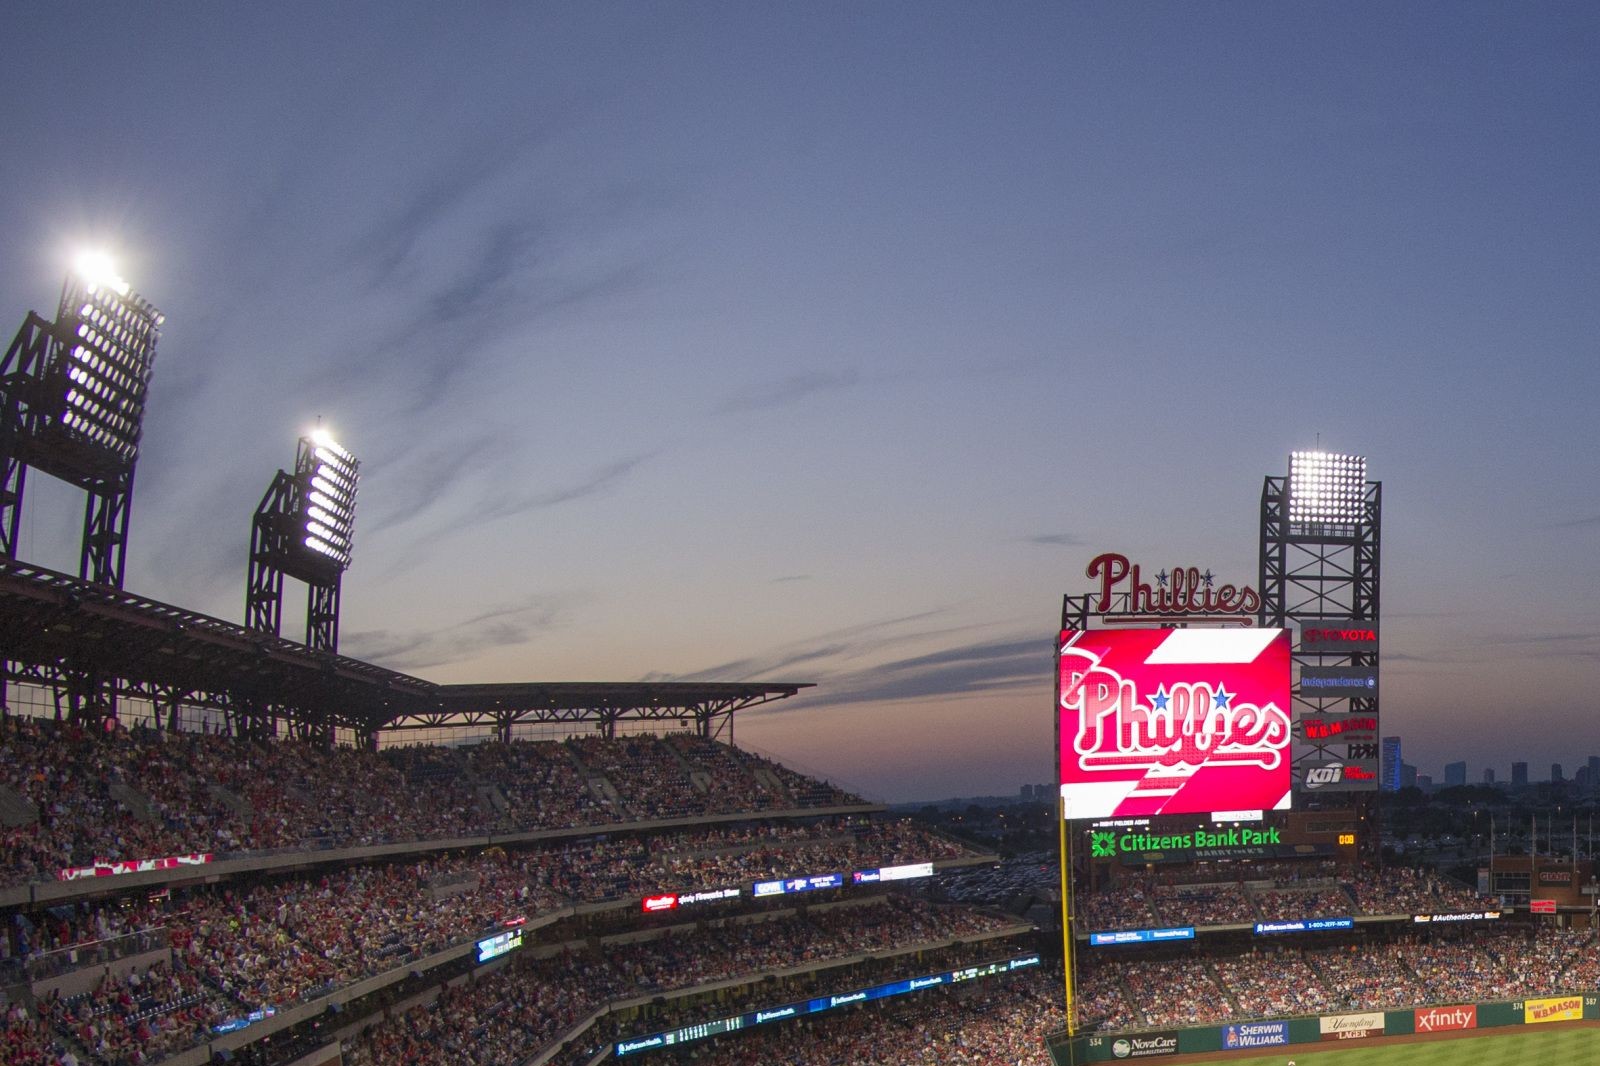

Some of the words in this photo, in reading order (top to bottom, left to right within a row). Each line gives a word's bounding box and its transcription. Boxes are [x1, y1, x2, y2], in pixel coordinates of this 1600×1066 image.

[1086, 553, 1261, 615] Phillies
[1322, 629, 1376, 641] TOYOTA
[1301, 677, 1364, 688] Independence
[1061, 648, 1291, 754] Phillies
[1119, 833, 1191, 852] Citizens
[1195, 829, 1239, 848] Bank
[1242, 826, 1280, 844] Park
[1539, 872, 1571, 881] GIANT
[1533, 1000, 1581, 1019] W.B.MASON
[1328, 1017, 1376, 1030] Yuengling
[1419, 1009, 1473, 1031] xfinity
[1240, 1024, 1282, 1035] SHERWIN
[1338, 1030, 1367, 1039] LAGER
[1131, 1037, 1177, 1050] NovaCare
